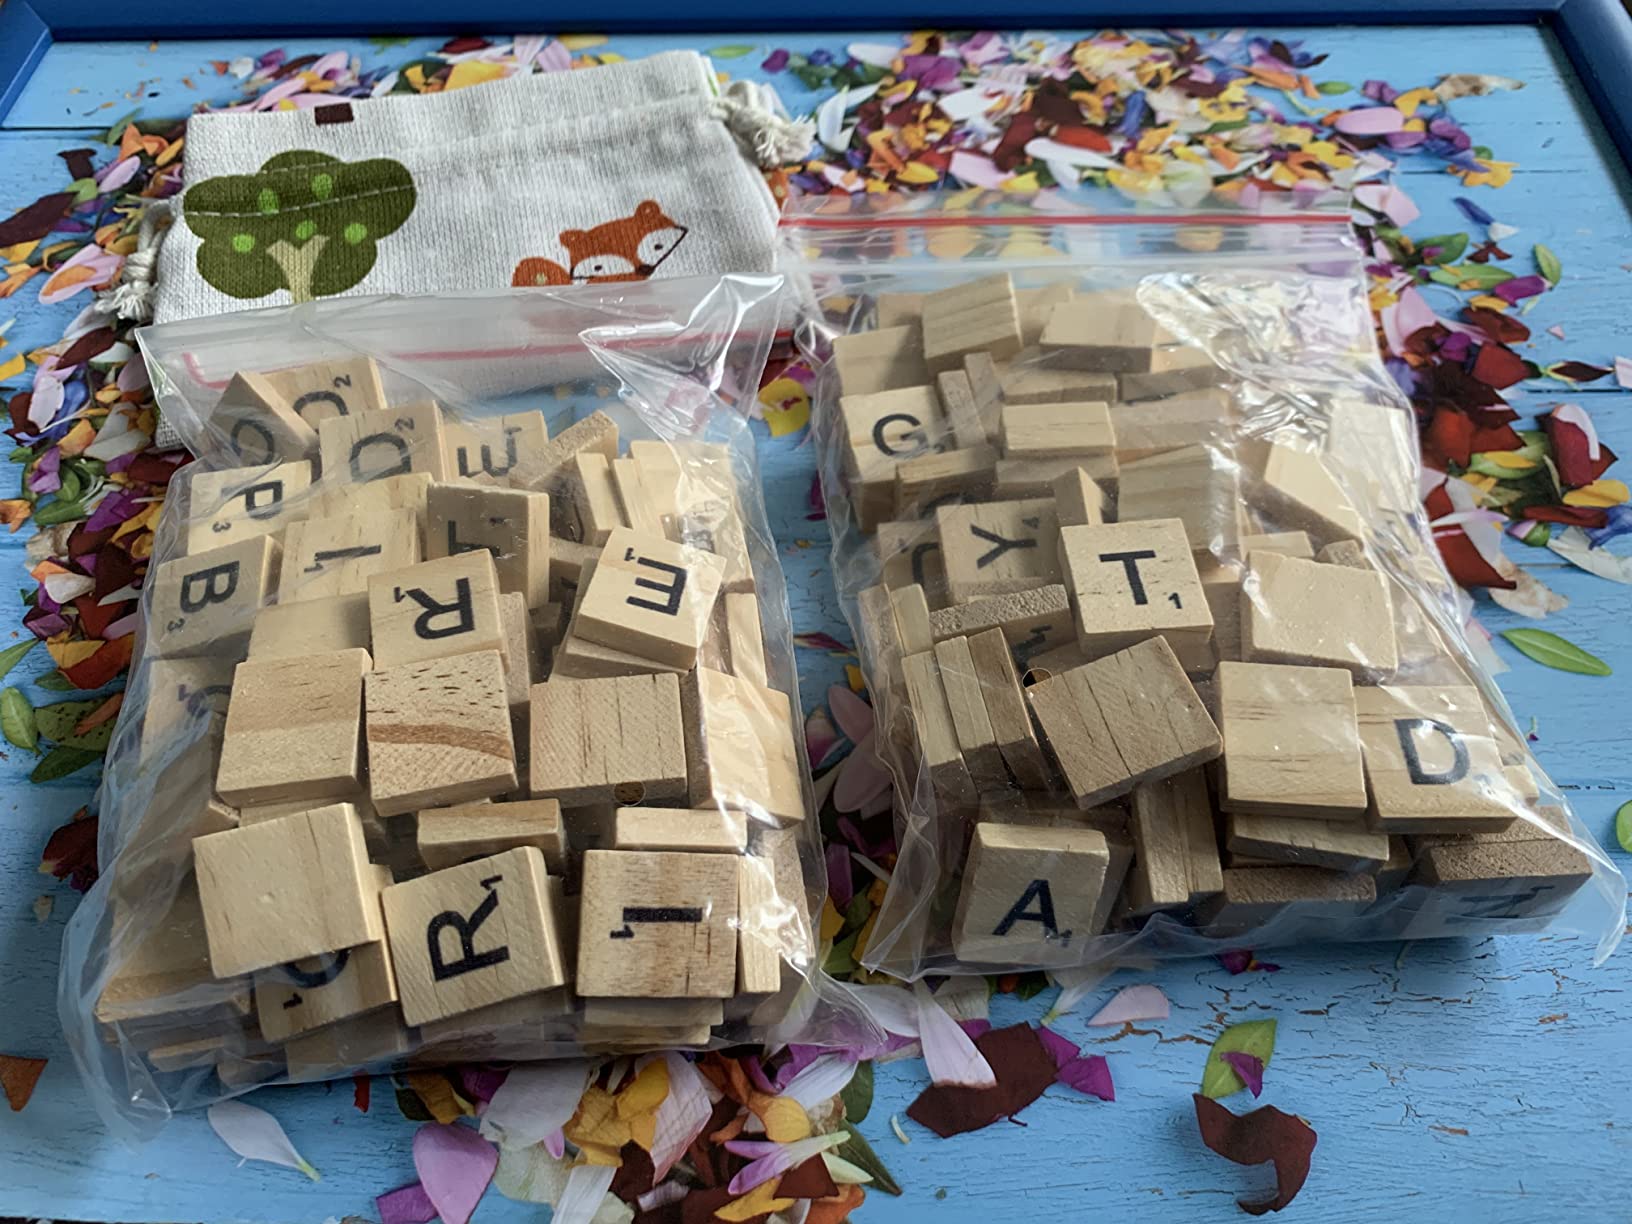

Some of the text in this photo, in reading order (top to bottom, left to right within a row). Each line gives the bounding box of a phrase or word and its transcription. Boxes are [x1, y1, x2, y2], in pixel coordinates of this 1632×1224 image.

[873, 413, 929, 460] G
[970, 524, 1038, 569] Y
[180, 561, 240, 613] B
[405, 577, 475, 640] R
[626, 556, 688, 616] E
[1098, 550, 1183, 610] T 1
[1394, 718, 1471, 785] D
[427, 888, 511, 982] R
[992, 879, 1060, 939] A
